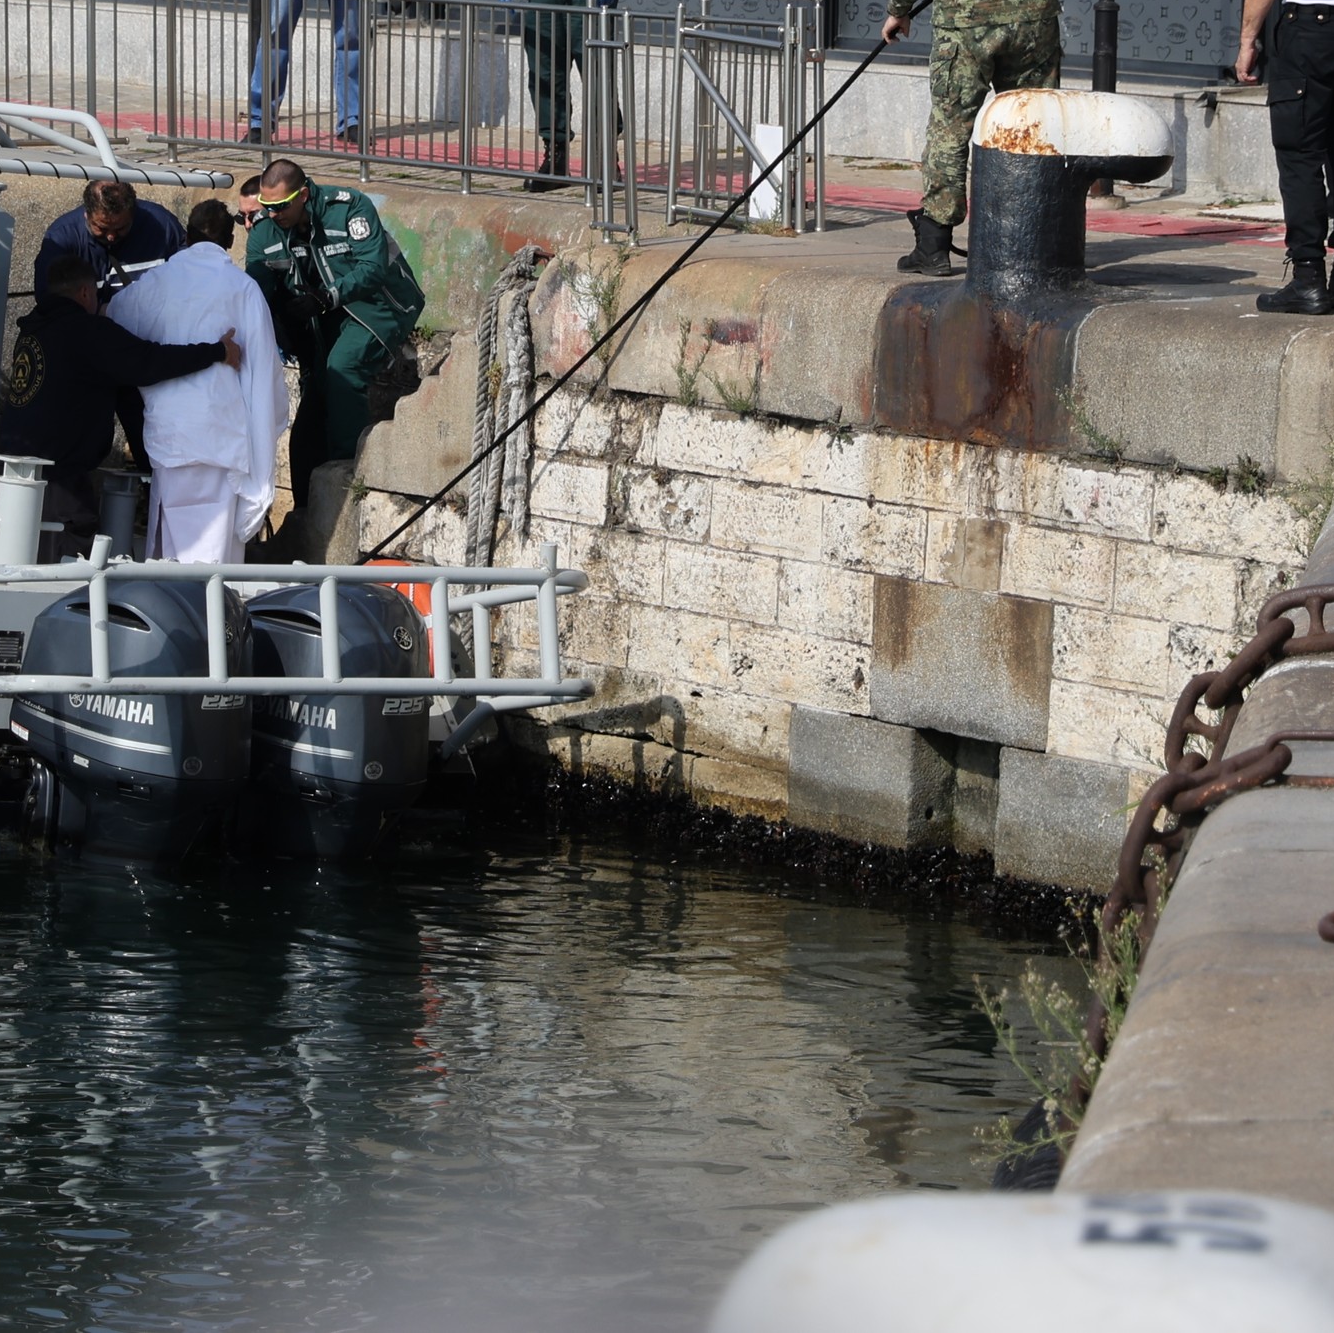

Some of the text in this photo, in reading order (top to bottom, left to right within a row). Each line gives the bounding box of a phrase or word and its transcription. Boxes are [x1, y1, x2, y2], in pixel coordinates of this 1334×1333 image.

[85, 694, 154, 725] YAMAHA
[267, 695, 337, 730] YAMAHA
[382, 696, 425, 715] 225
